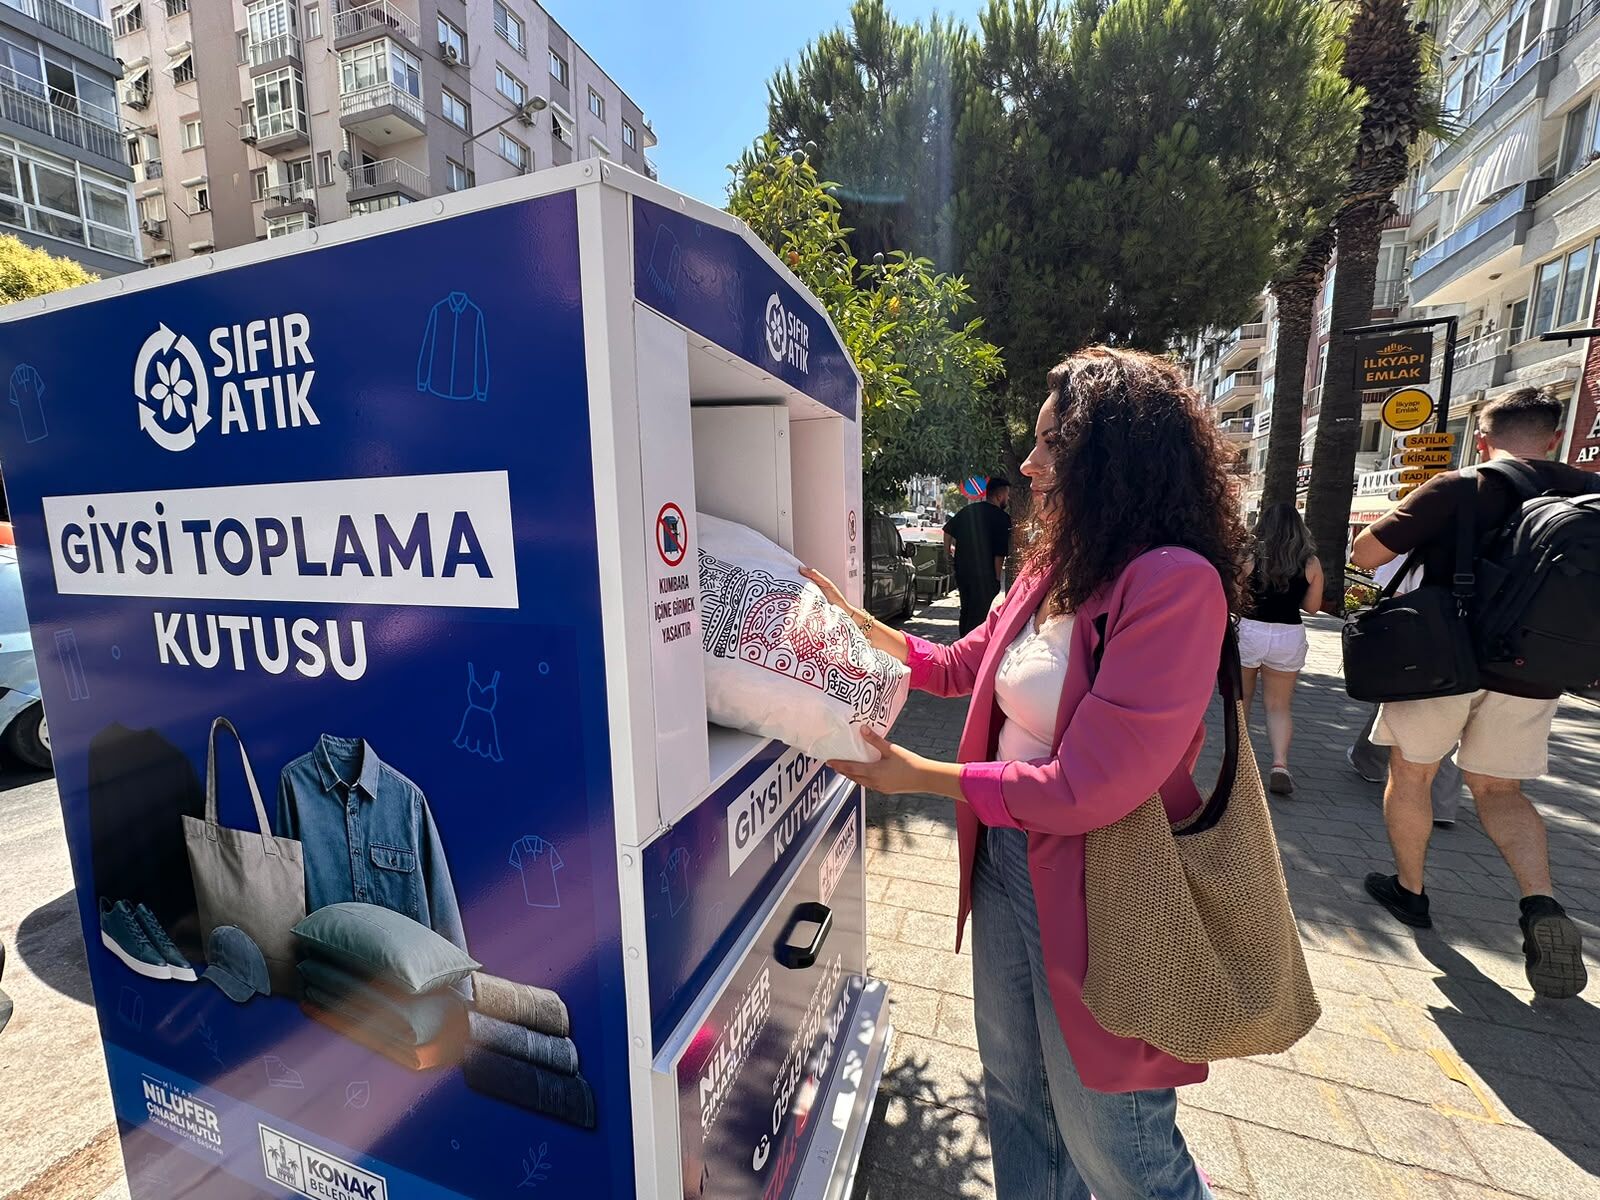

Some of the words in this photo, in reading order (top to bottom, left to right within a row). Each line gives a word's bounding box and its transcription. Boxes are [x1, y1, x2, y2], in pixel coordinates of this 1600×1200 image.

[209, 313, 314, 376] SIFIR
[788, 311, 809, 349] SIFIR
[788, 339, 809, 375] ATIK
[1364, 354, 1425, 368] İLKYAPI
[1366, 368, 1420, 382] EMLAK
[221, 371, 320, 434] ATIK
[1407, 454, 1447, 463] KİRALIK
[1410, 436, 1448, 445] SATILIK
[1362, 474, 1389, 489] AVUK
[1403, 472, 1432, 480] TADİL
[61, 501, 173, 575] GİYSİ
[182, 511, 493, 579] TOPLAMA
[658, 574, 690, 594] KUMBARA
[654, 601, 672, 623] İÇİNE
[672, 597, 695, 616] GİRMEK
[154, 612, 367, 680] KUTUSU
[661, 621, 691, 643] YASAKTIR
[735, 763, 782, 849] GİYSİ
[773, 769, 826, 863] KUTUSU
[701, 1045, 742, 1129] ÇINARLI
[742, 990, 770, 1052] MUTLU
[773, 1049, 802, 1136] 0549
[803, 1004, 821, 1066] 250
[163, 1081, 192, 1098] MİMAR
[146, 1102, 185, 1128] ÇINARLI
[186, 1119, 221, 1145] MUTLU
[307, 1156, 376, 1200] KONAK
